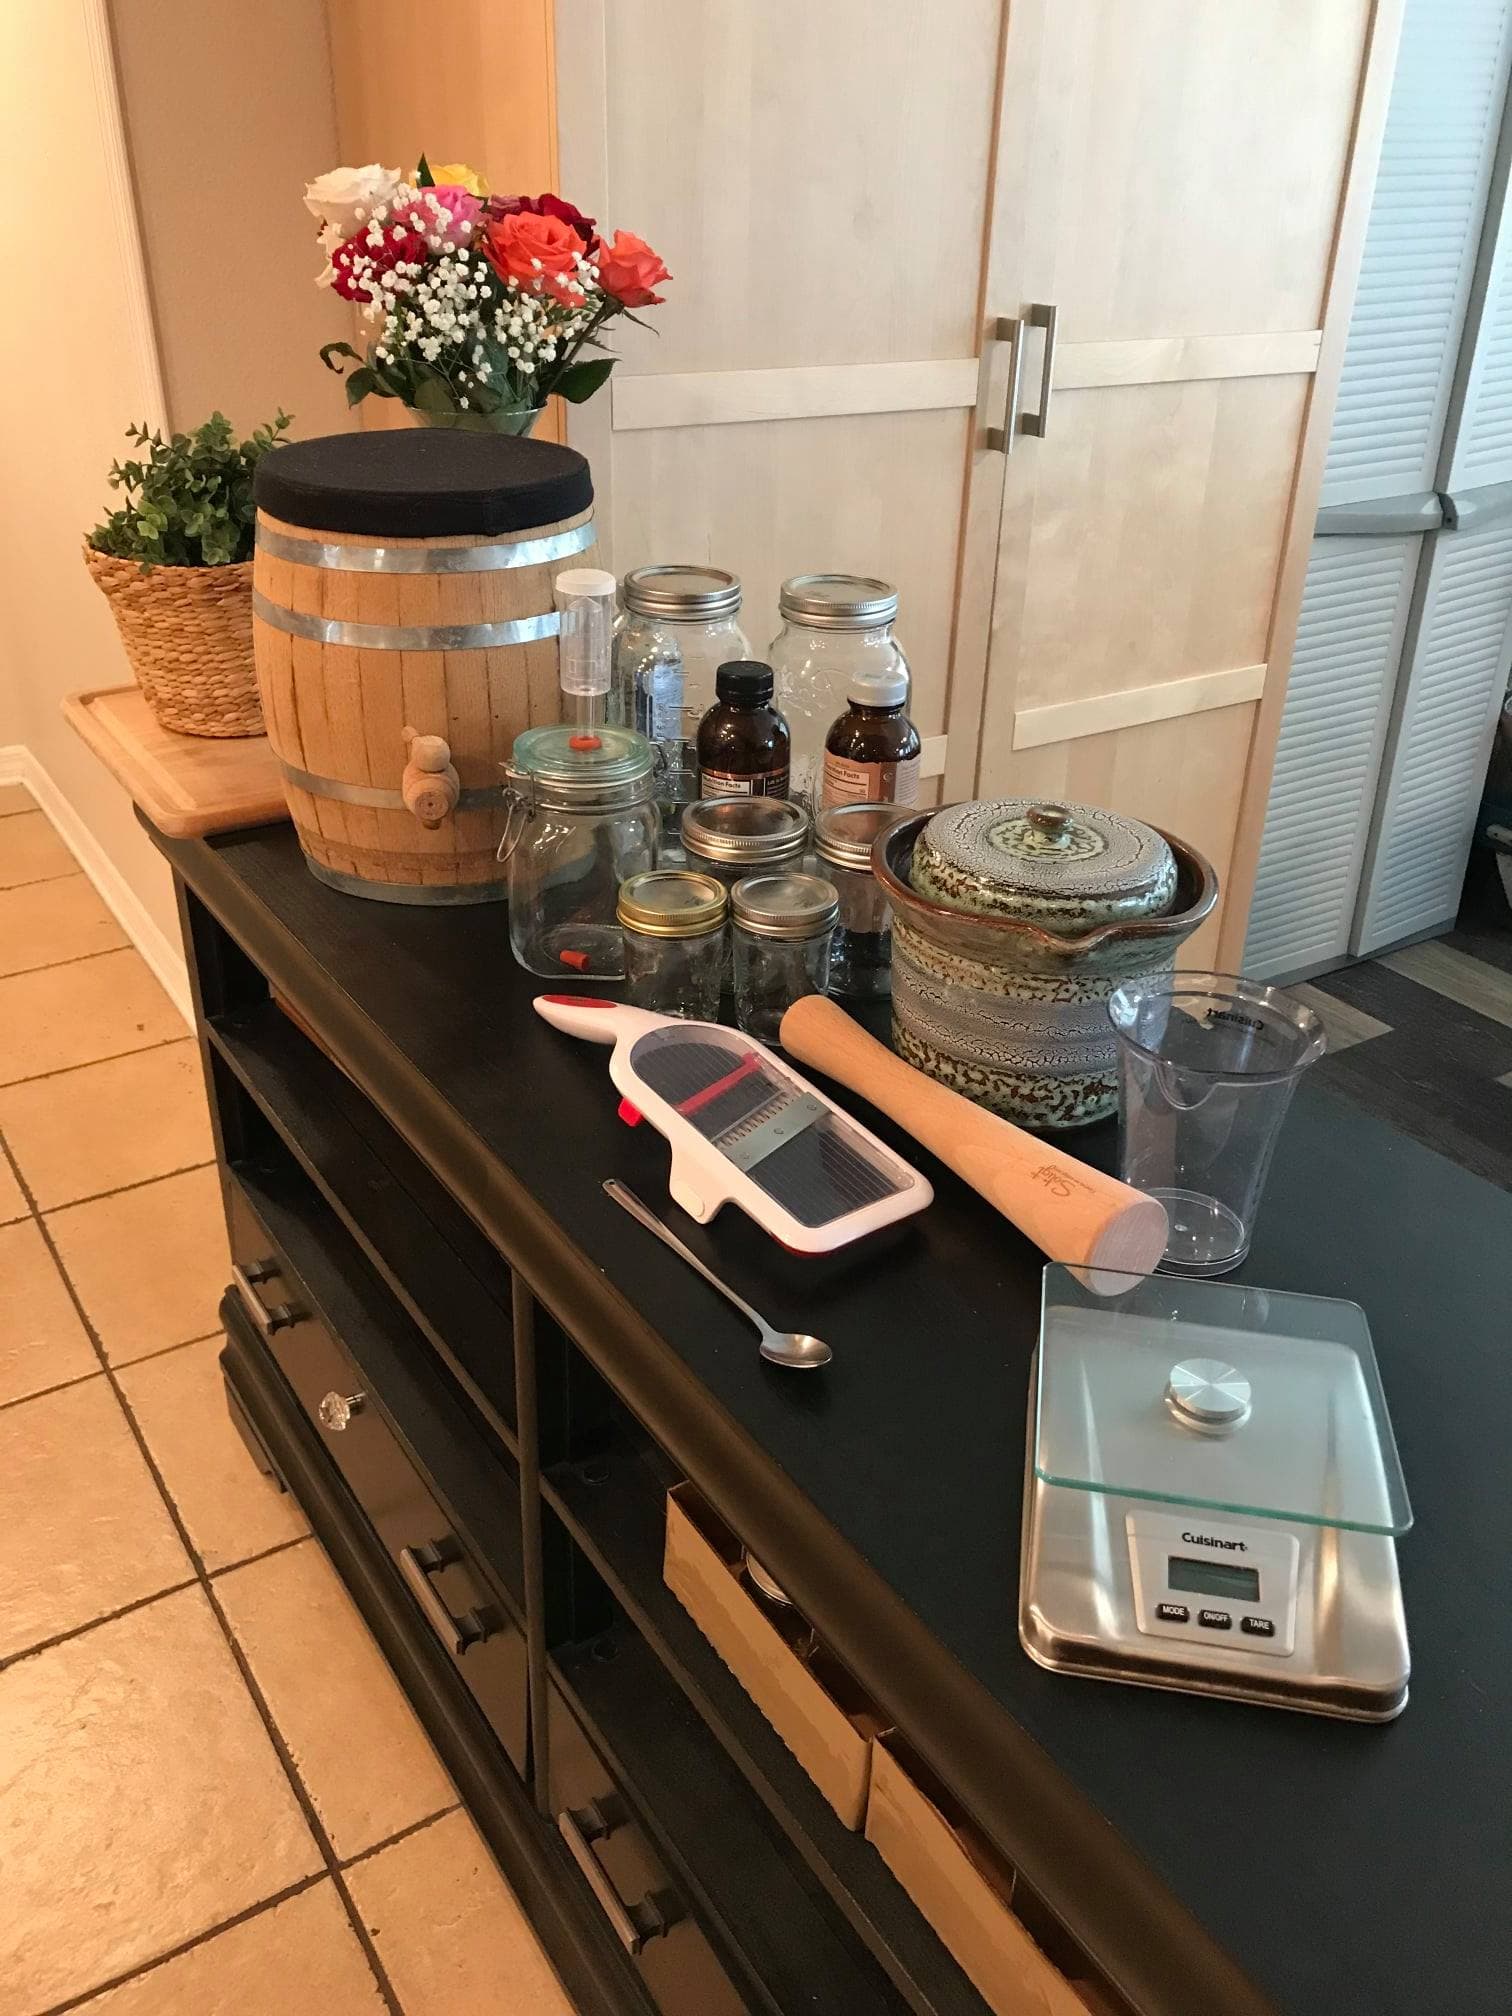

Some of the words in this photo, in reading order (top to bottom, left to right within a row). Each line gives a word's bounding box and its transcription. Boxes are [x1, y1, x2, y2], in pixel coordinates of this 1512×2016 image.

[1181, 1532, 1246, 1552] Cuisinart
[1162, 1605, 1185, 1616] MODE
[1203, 1611, 1229, 1622] ON/OFF
[1249, 1618, 1270, 1630] TARE
